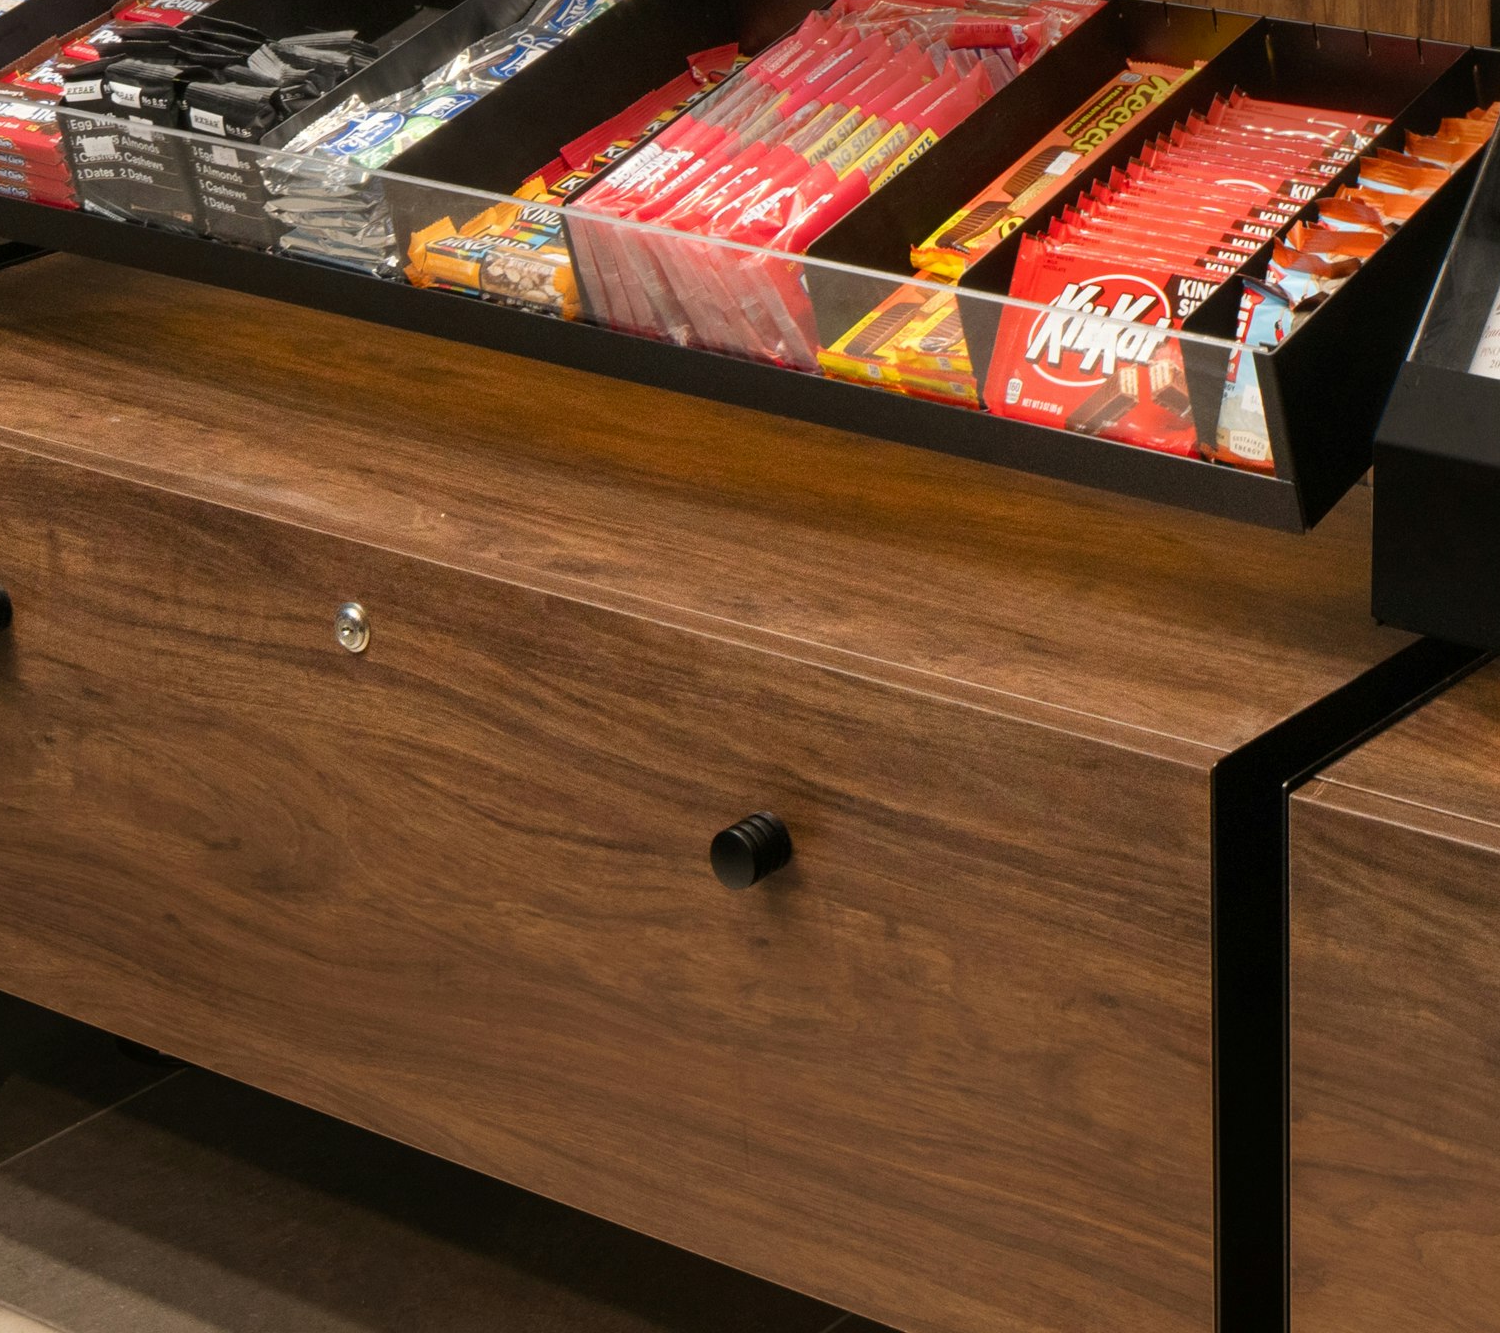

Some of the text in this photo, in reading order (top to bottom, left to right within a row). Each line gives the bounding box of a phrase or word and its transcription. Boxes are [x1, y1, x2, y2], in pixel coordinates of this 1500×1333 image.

[195, 115, 222, 131] RXBAR
[202, 165, 243, 183] Almonds
[206, 181, 248, 200] Cashews
